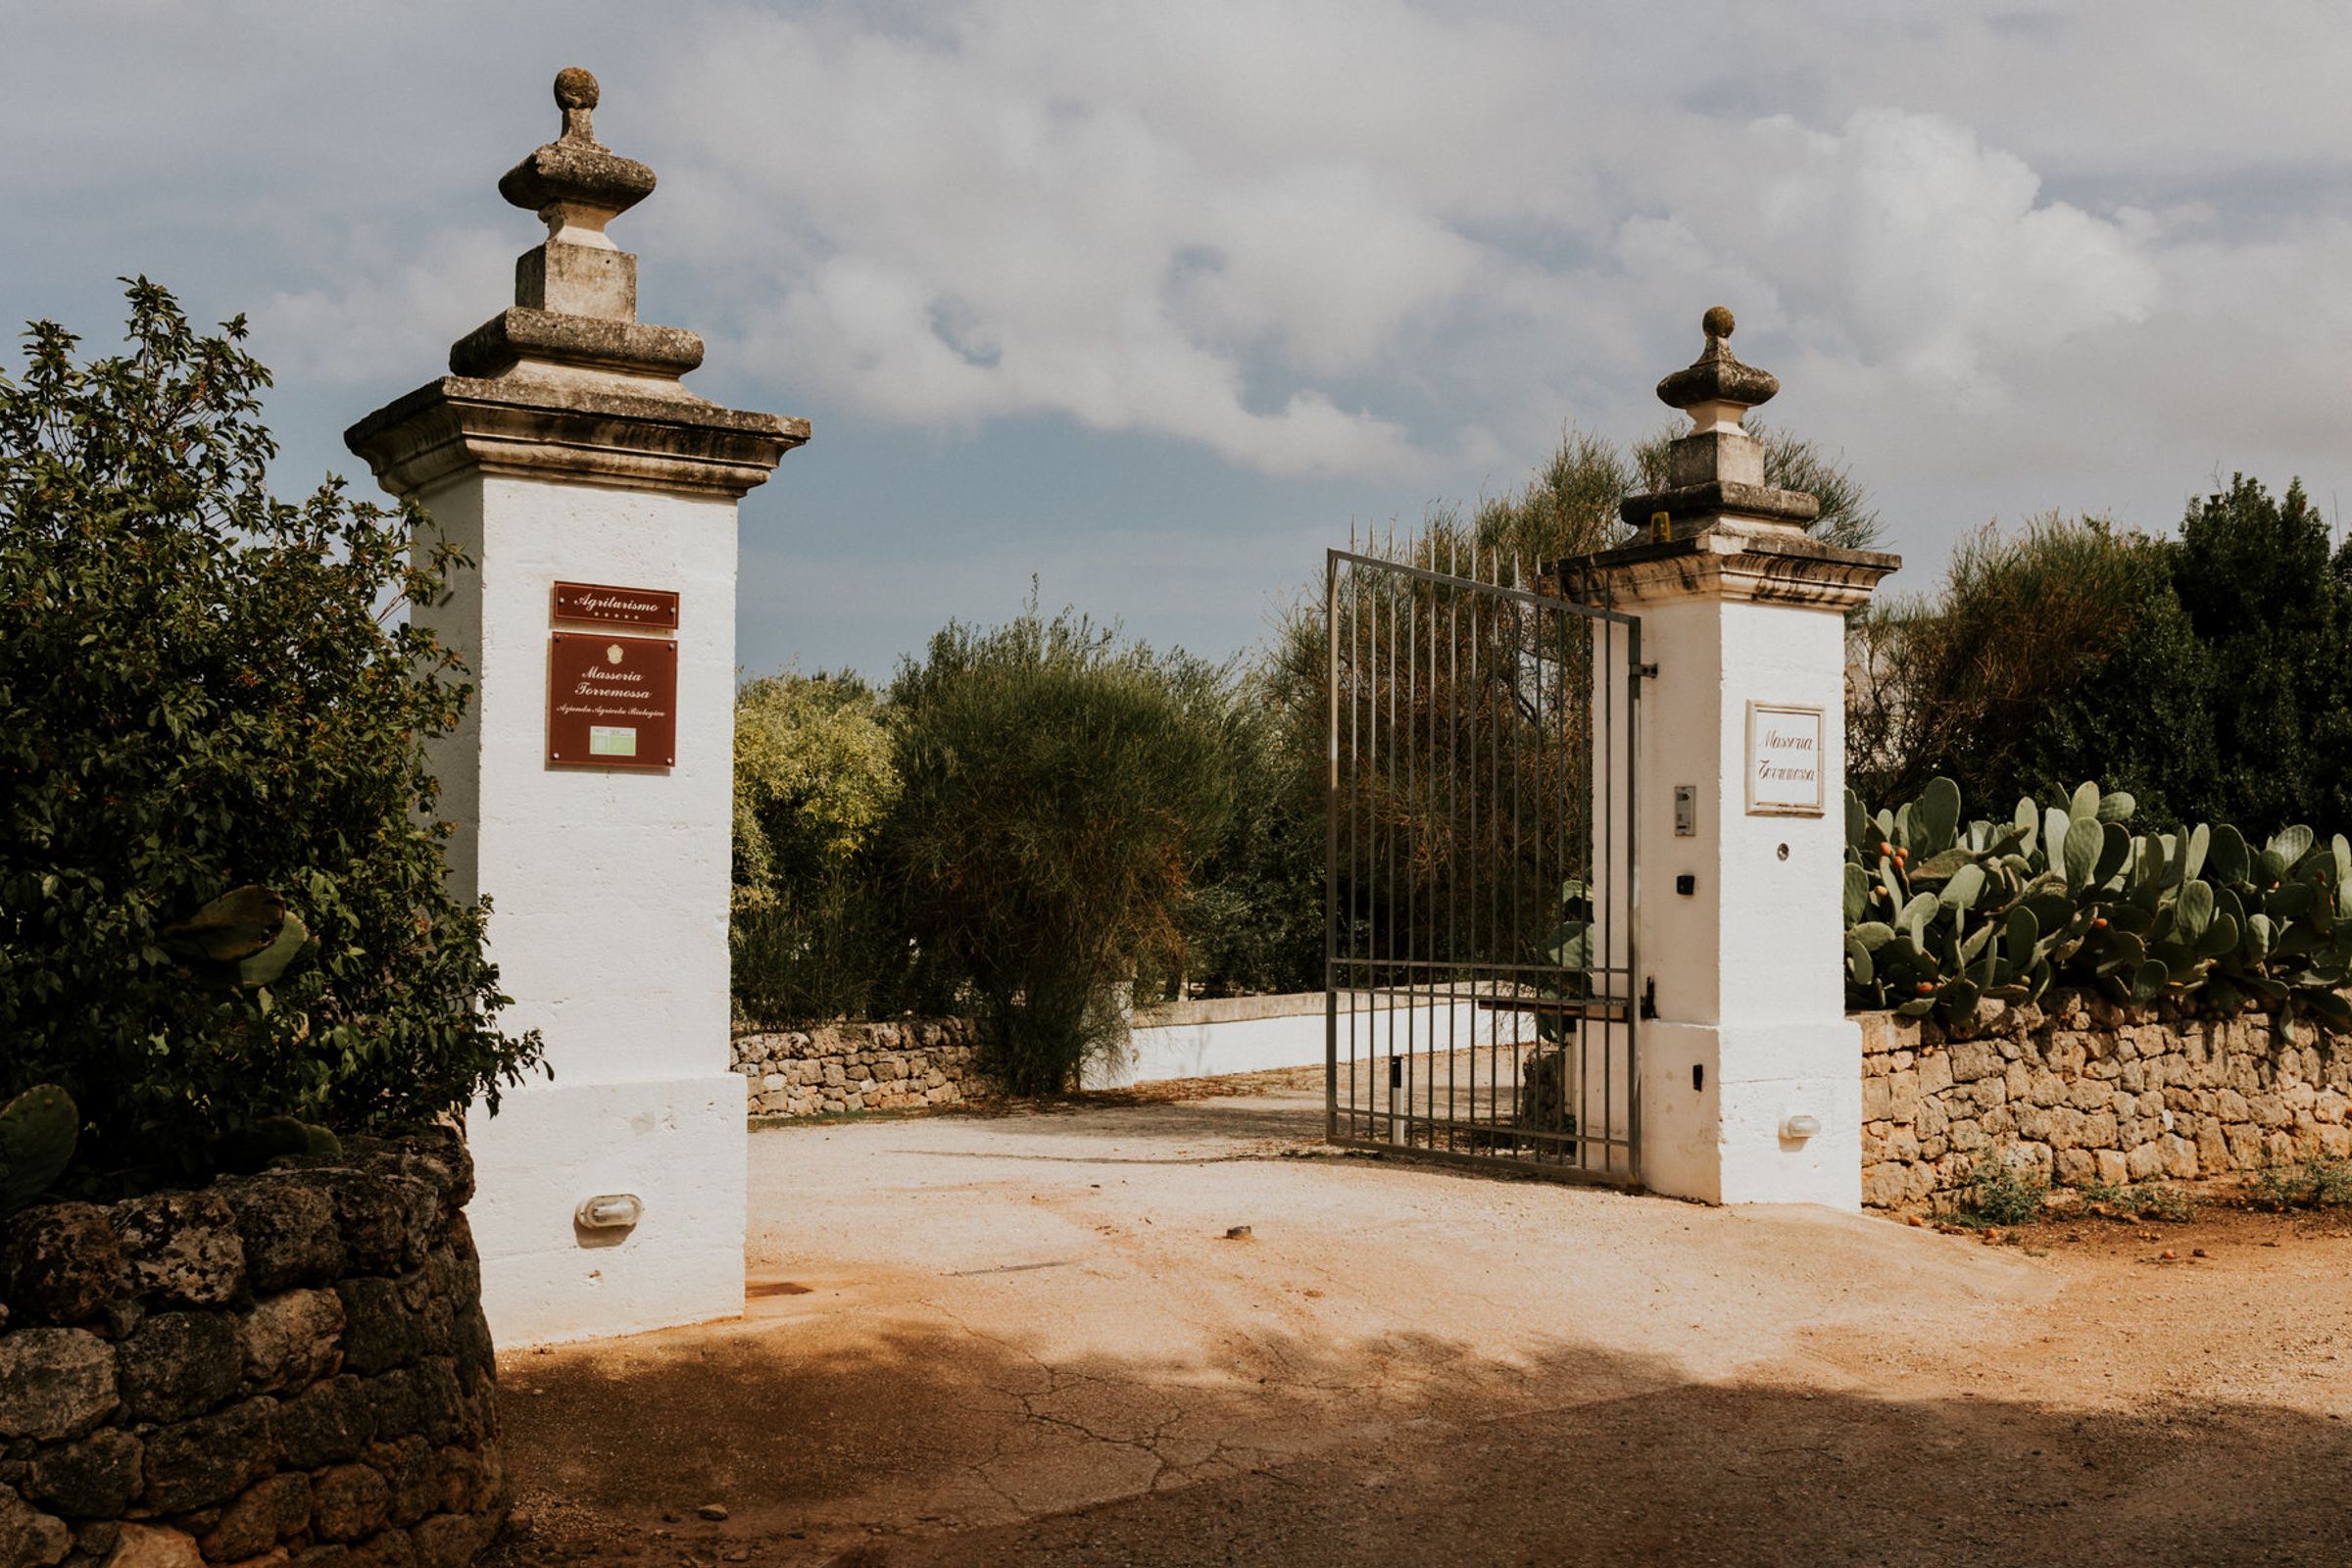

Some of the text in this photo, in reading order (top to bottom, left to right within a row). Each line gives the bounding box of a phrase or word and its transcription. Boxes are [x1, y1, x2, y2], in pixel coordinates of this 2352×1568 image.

[573, 593, 660, 612] Agriturismo
[581, 666, 644, 682] Masseria
[574, 681, 653, 699] Torremossa
[557, 704, 666, 718] Azienda Agricola Biologica
